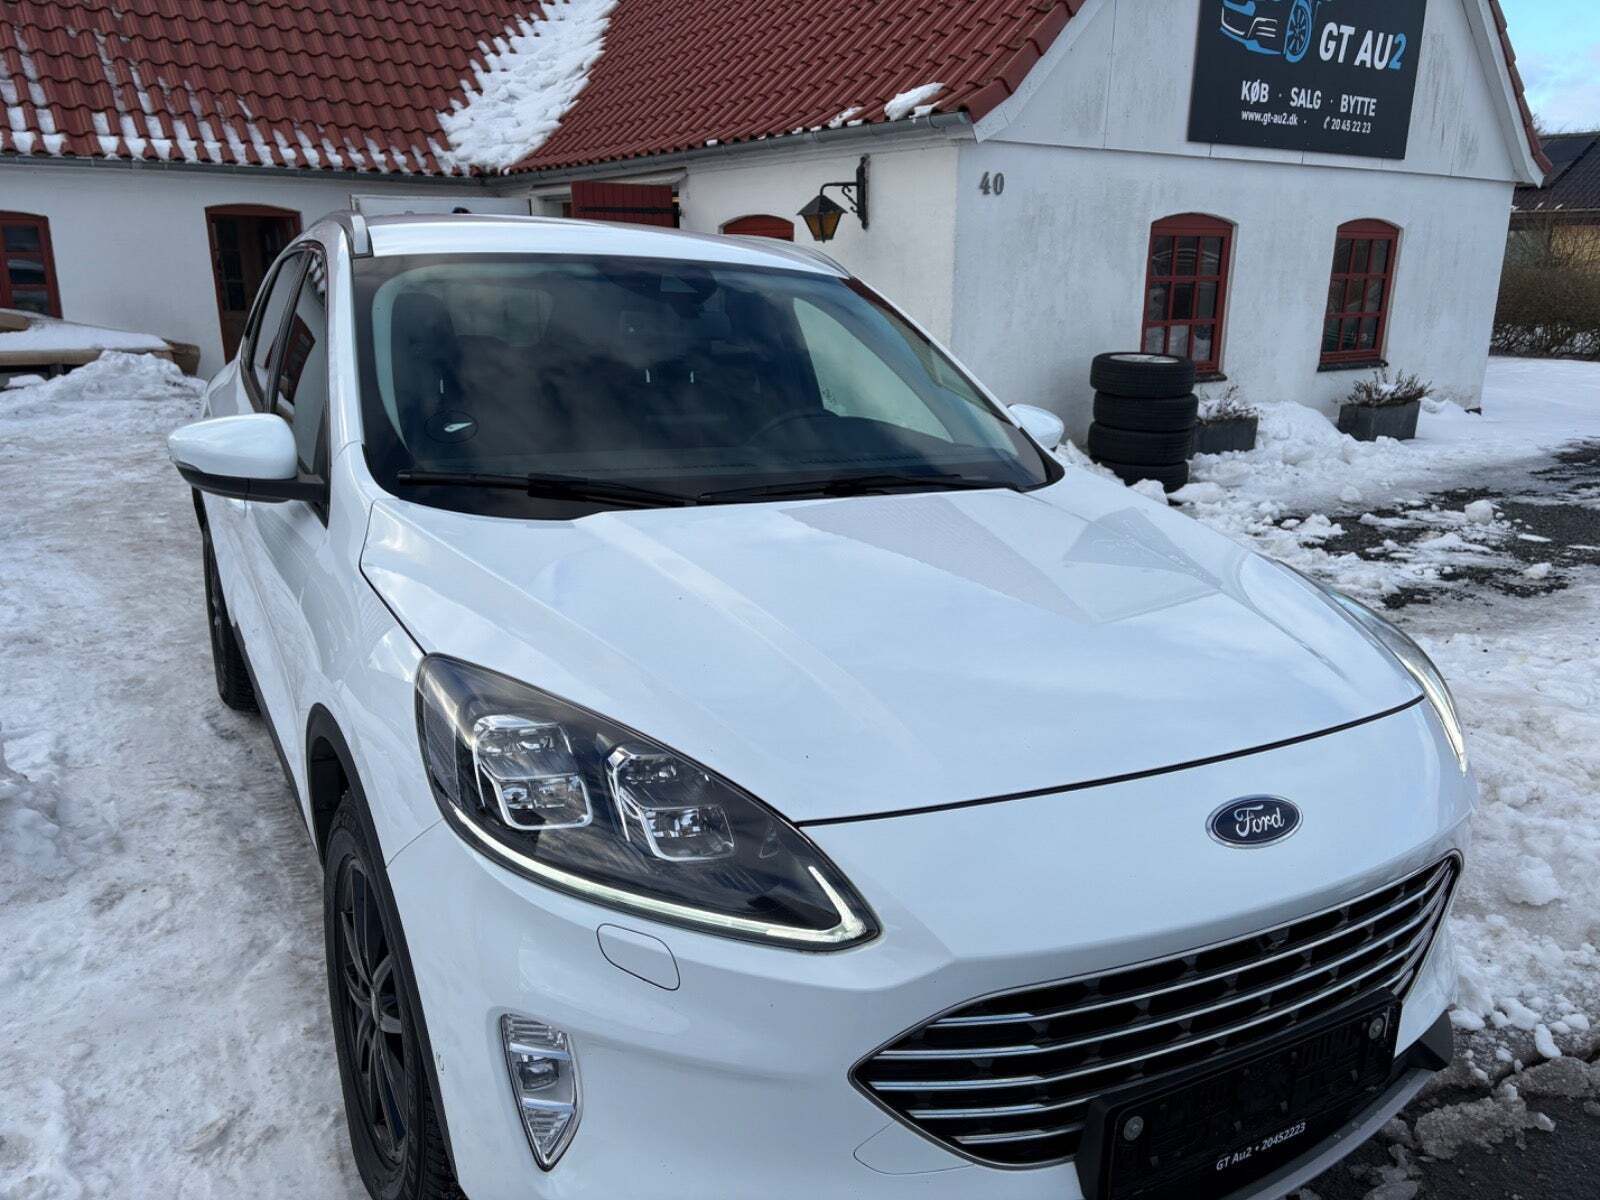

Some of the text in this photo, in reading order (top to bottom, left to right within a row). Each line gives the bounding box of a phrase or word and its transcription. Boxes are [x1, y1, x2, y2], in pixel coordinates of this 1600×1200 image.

[1319, 22, 1407, 70] GT AU2
[1241, 79, 1377, 117] KØB SALG BYTTE
[1241, 110, 1298, 126] www.gt-au2.dk
[1331, 118, 1341, 130] 20
[1351, 120, 1361, 133] 22
[1362, 121, 1371, 134] 23
[979, 171, 1005, 196] 40
[1234, 804, 1285, 838] Ford
[1216, 1121, 1306, 1171] GT Au2 20452223
